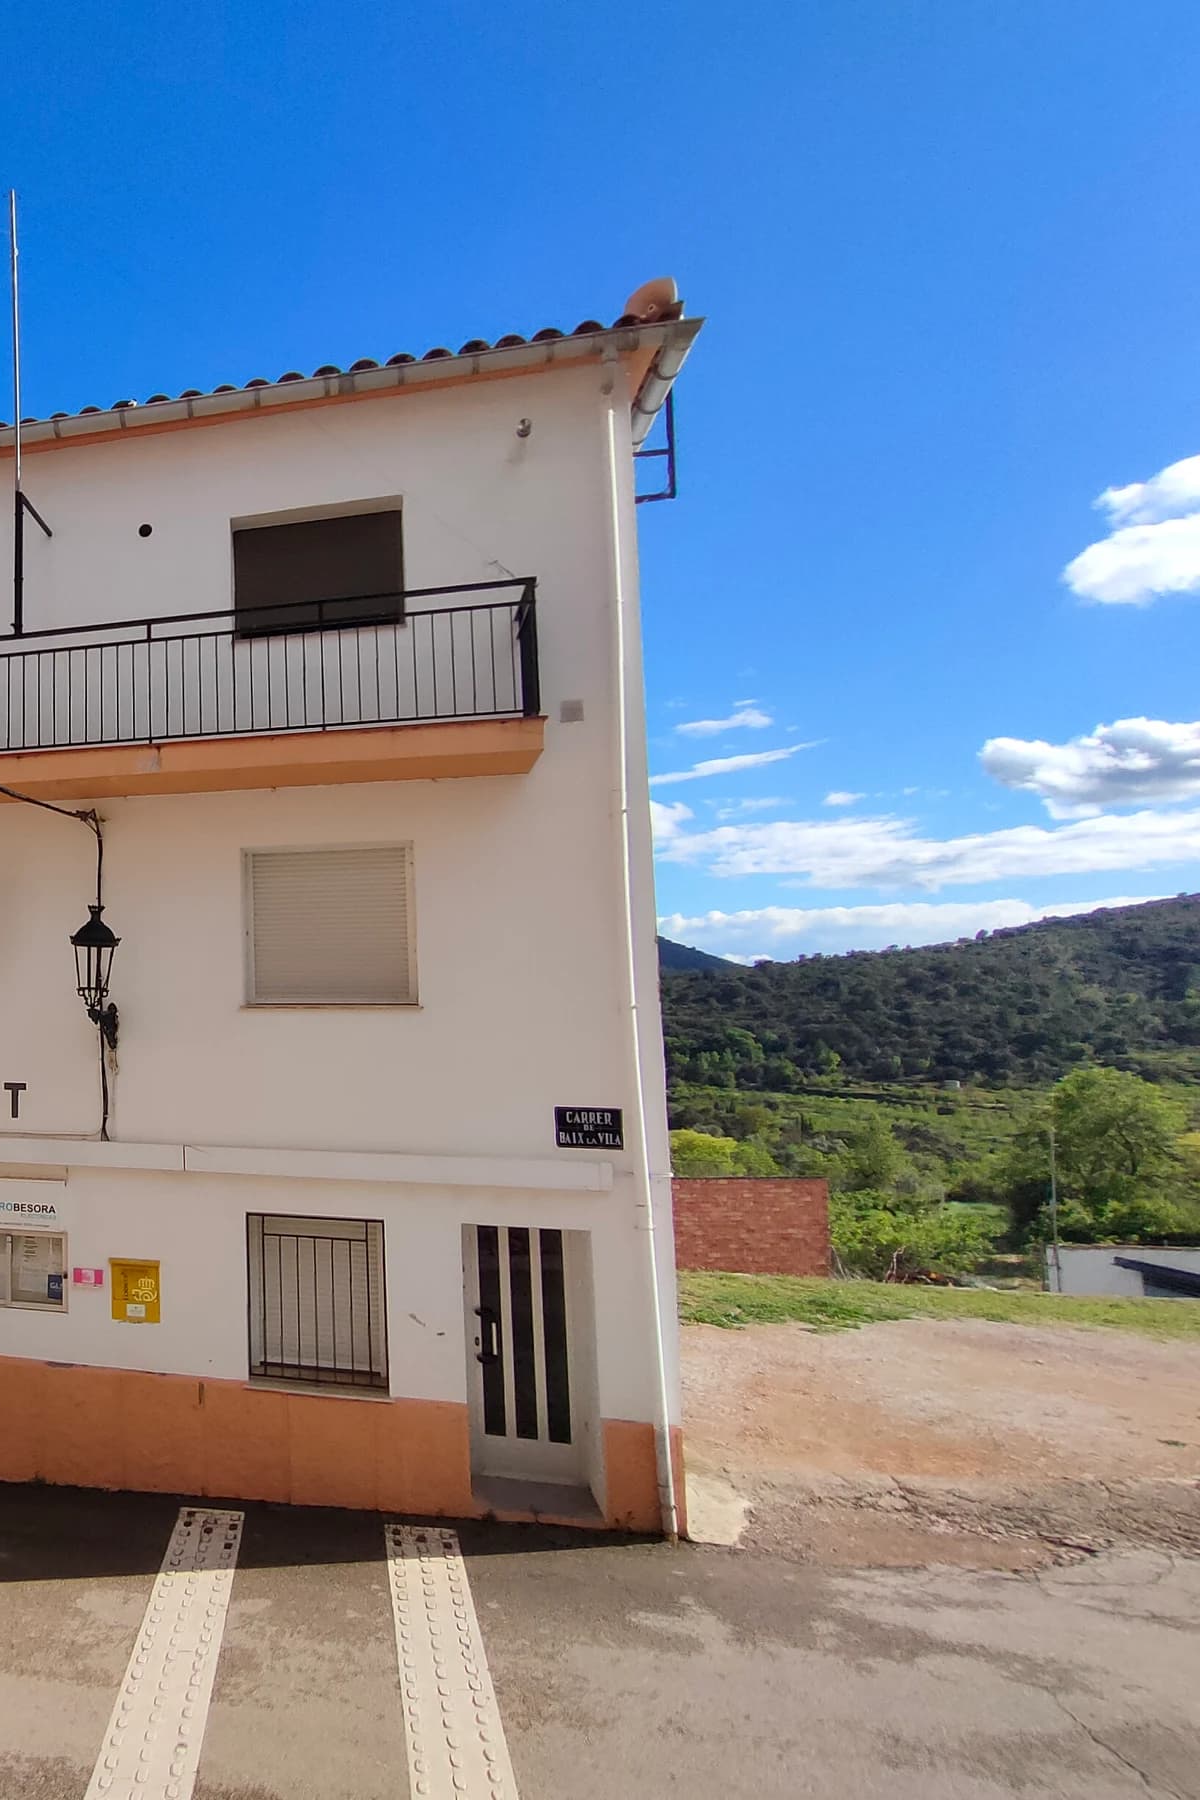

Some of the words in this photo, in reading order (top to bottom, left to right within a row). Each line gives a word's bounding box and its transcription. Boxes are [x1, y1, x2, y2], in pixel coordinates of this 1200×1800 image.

[566, 1111, 612, 1125] CARRER
[559, 1132, 584, 1144] BAIX
[598, 1132, 621, 1145] VILA
